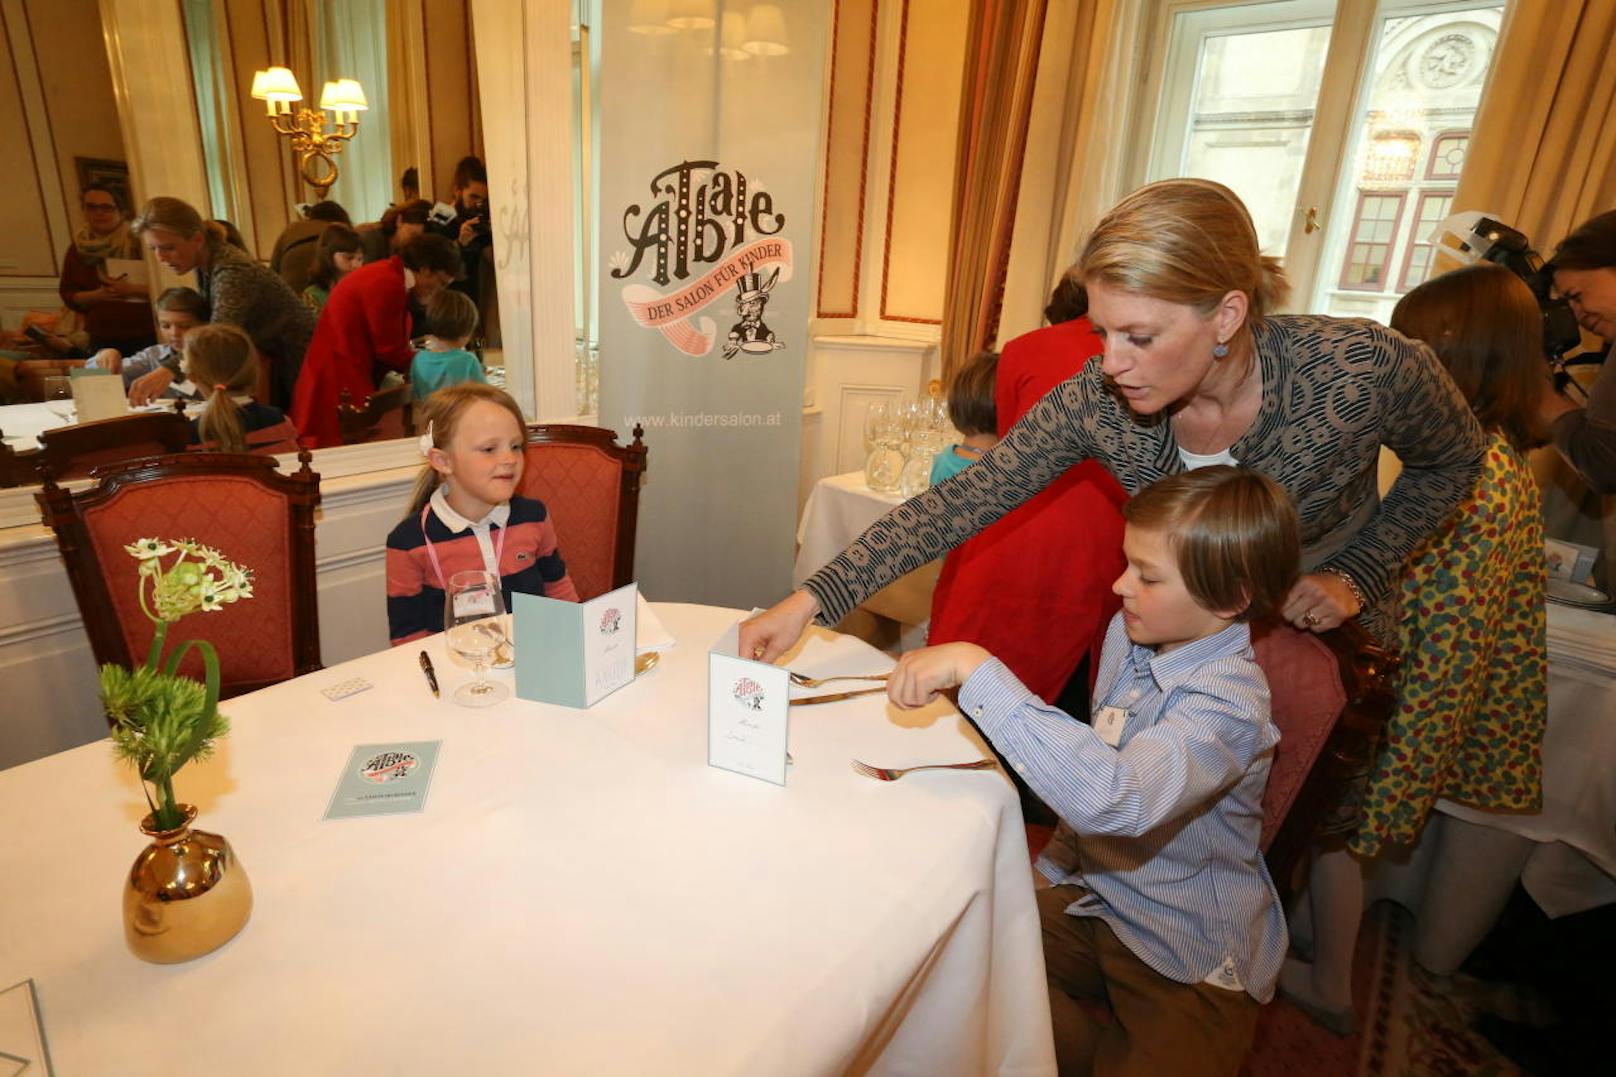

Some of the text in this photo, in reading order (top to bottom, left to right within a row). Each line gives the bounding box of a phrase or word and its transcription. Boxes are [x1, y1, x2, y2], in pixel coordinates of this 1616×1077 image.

[647, 243, 782, 321] DER SALON FÜR KINDER
[623, 410, 781, 427] www.kindersalon.at
